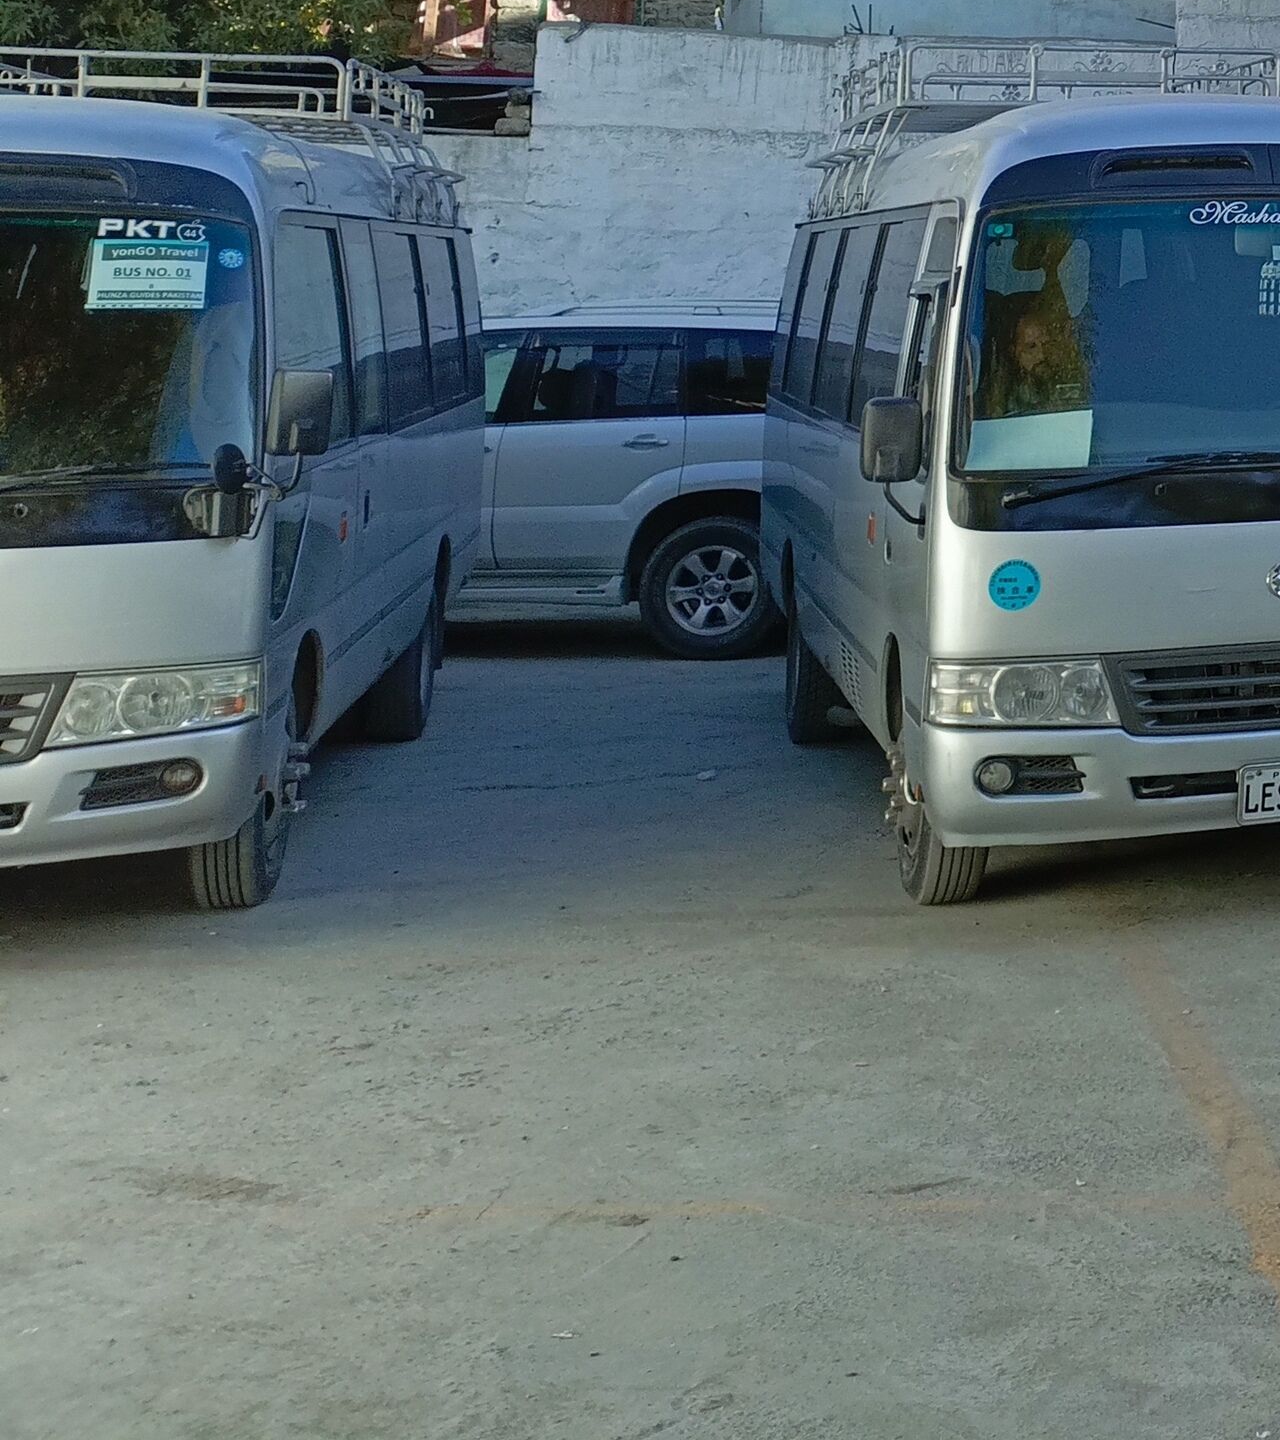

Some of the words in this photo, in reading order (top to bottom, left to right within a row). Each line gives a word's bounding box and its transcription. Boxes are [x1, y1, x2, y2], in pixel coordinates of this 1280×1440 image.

[97, 217, 177, 238] PKT
[183, 228, 198, 238] 44
[111, 246, 156, 258] yonGO
[159, 247, 199, 258] Travel
[112, 267, 141, 277] BUS
[145, 267, 171, 277] NO.
[175, 268, 192, 278] 01
